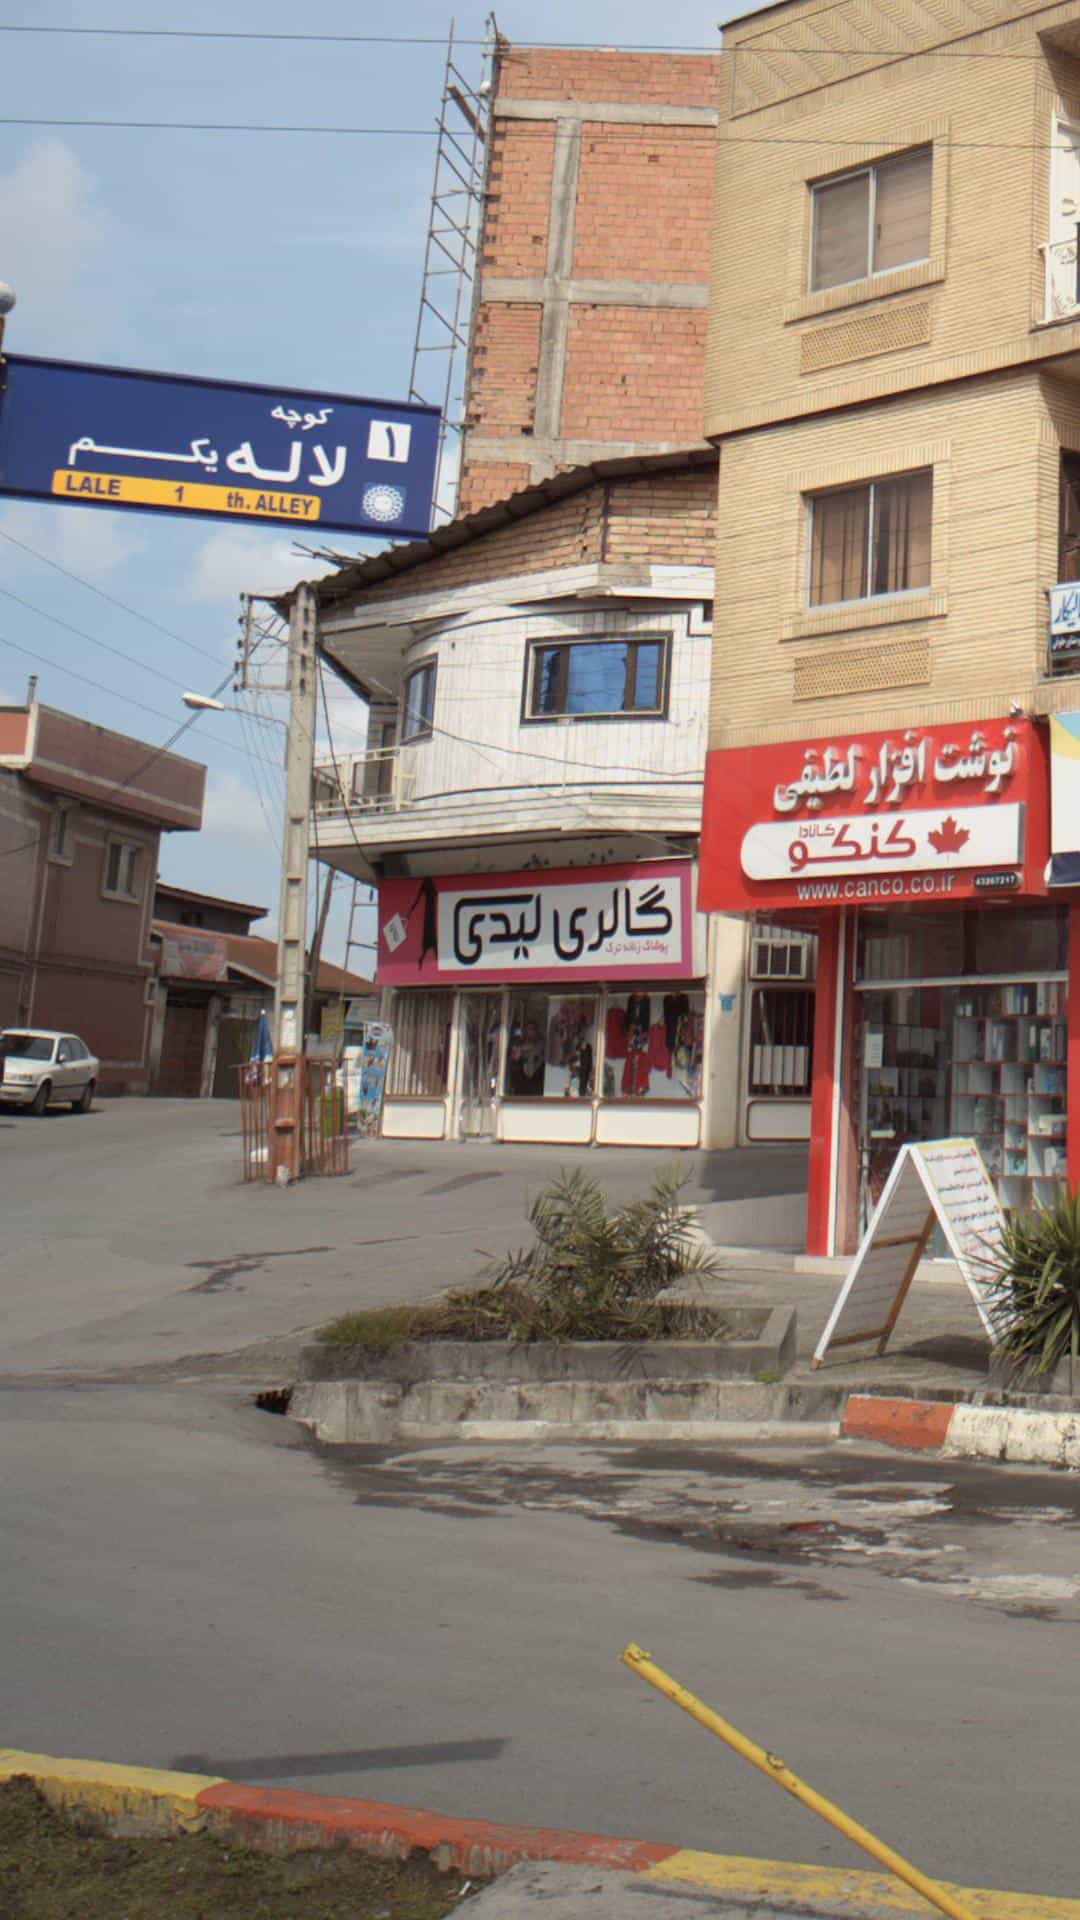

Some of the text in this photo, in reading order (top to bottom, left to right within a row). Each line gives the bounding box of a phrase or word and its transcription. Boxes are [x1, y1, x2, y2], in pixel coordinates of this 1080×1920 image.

[270, 404, 334, 430] کوچه
[67, 434, 348, 487] لاله یکم
[65, 474, 314, 516] LALE 1 th. ALLEY
[772, 725, 1019, 812] نوشت افزار لطیفی
[788, 819, 917, 873] کنکو
[798, 823, 836, 839] کانادا
[796, 874, 956, 901] www.canco.co.ir
[453, 884, 673, 965] گالری لیدی
